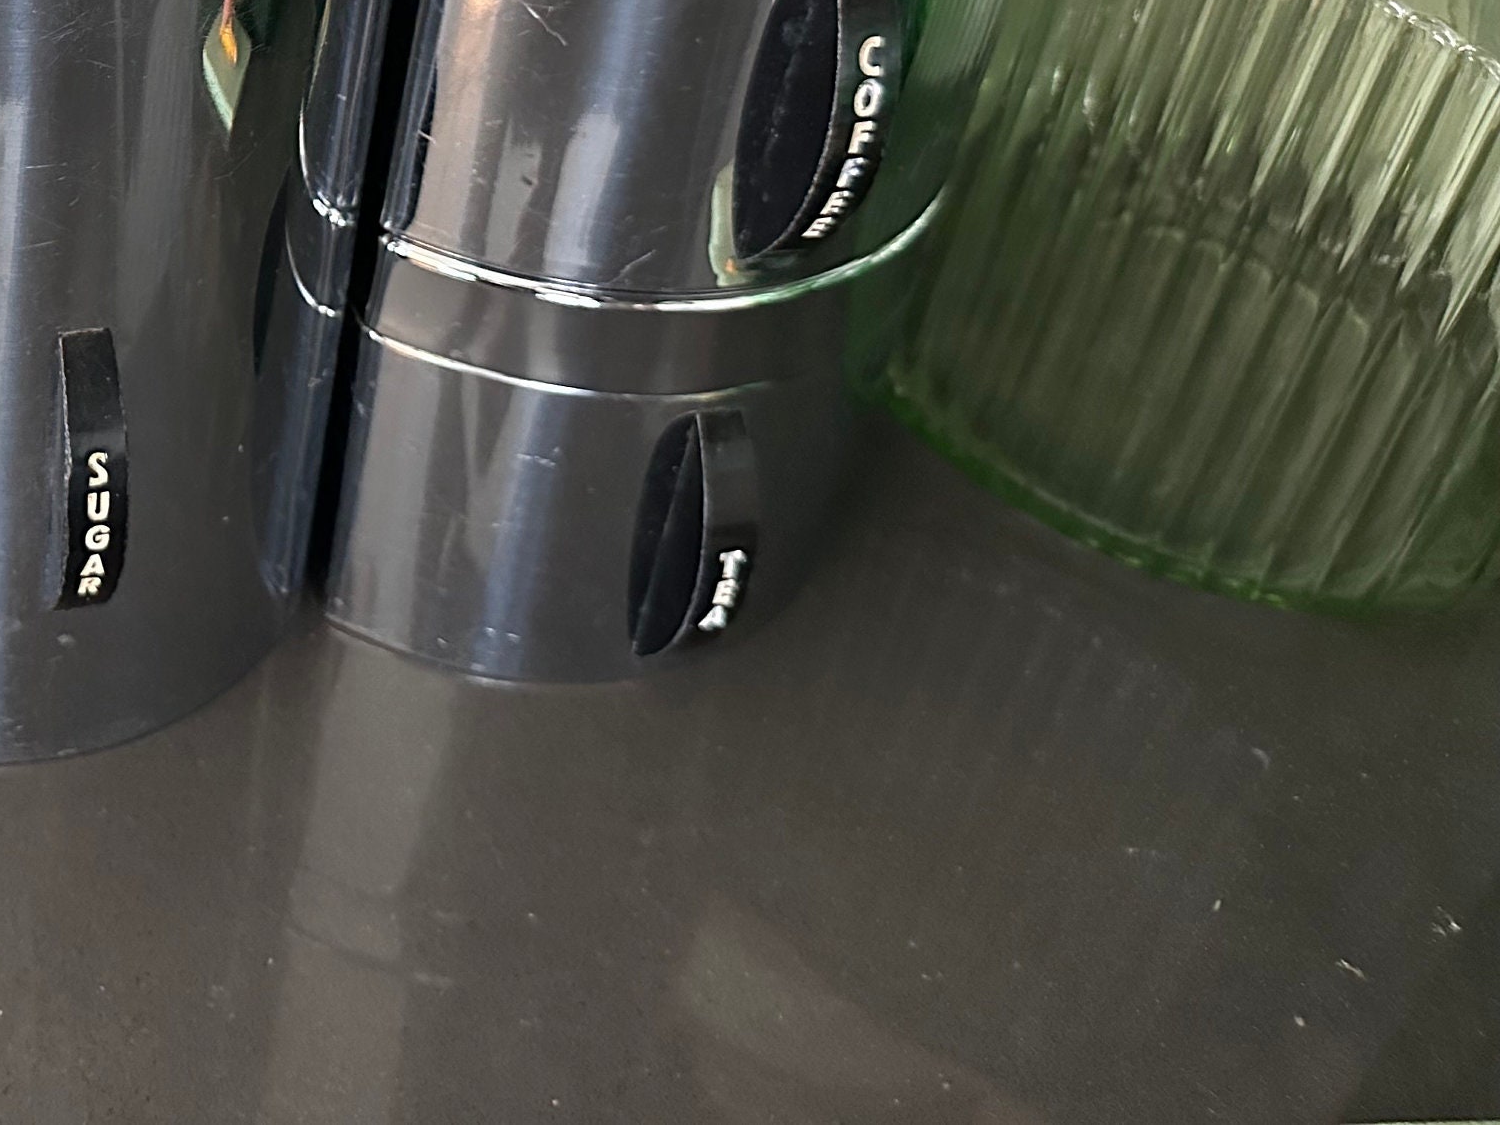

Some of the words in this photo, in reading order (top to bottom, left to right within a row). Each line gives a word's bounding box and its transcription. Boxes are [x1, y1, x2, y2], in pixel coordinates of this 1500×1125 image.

[801, 35, 886, 239] COFFEE
[77, 451, 111, 596] SUGAR
[697, 549, 747, 631] TEA
